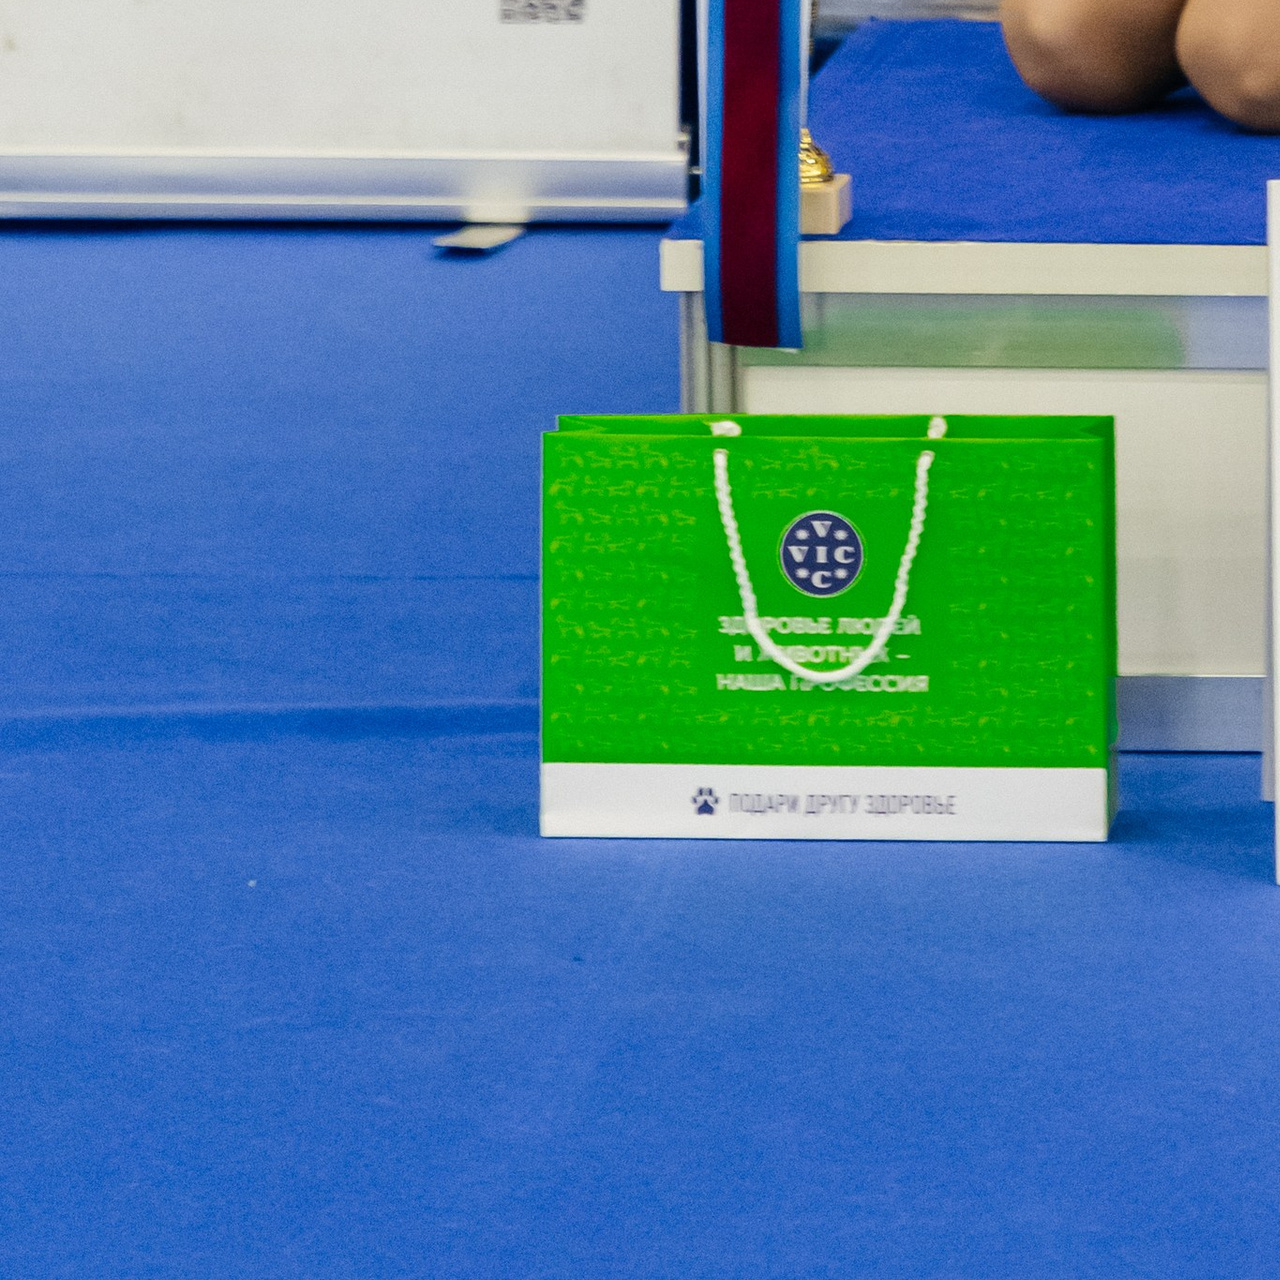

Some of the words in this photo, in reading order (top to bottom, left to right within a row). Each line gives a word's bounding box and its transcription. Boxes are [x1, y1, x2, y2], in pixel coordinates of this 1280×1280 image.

[787, 545, 856, 564] VIC
[718, 616, 833, 635] ЗДРОВЬЕ
[716, 673, 787, 690] НАША
[730, 793, 799, 814] ПОДАРИ
[805, 793, 861, 815] ДРУГУ
[865, 794, 957, 815] ЗДОРОВЬЕ
